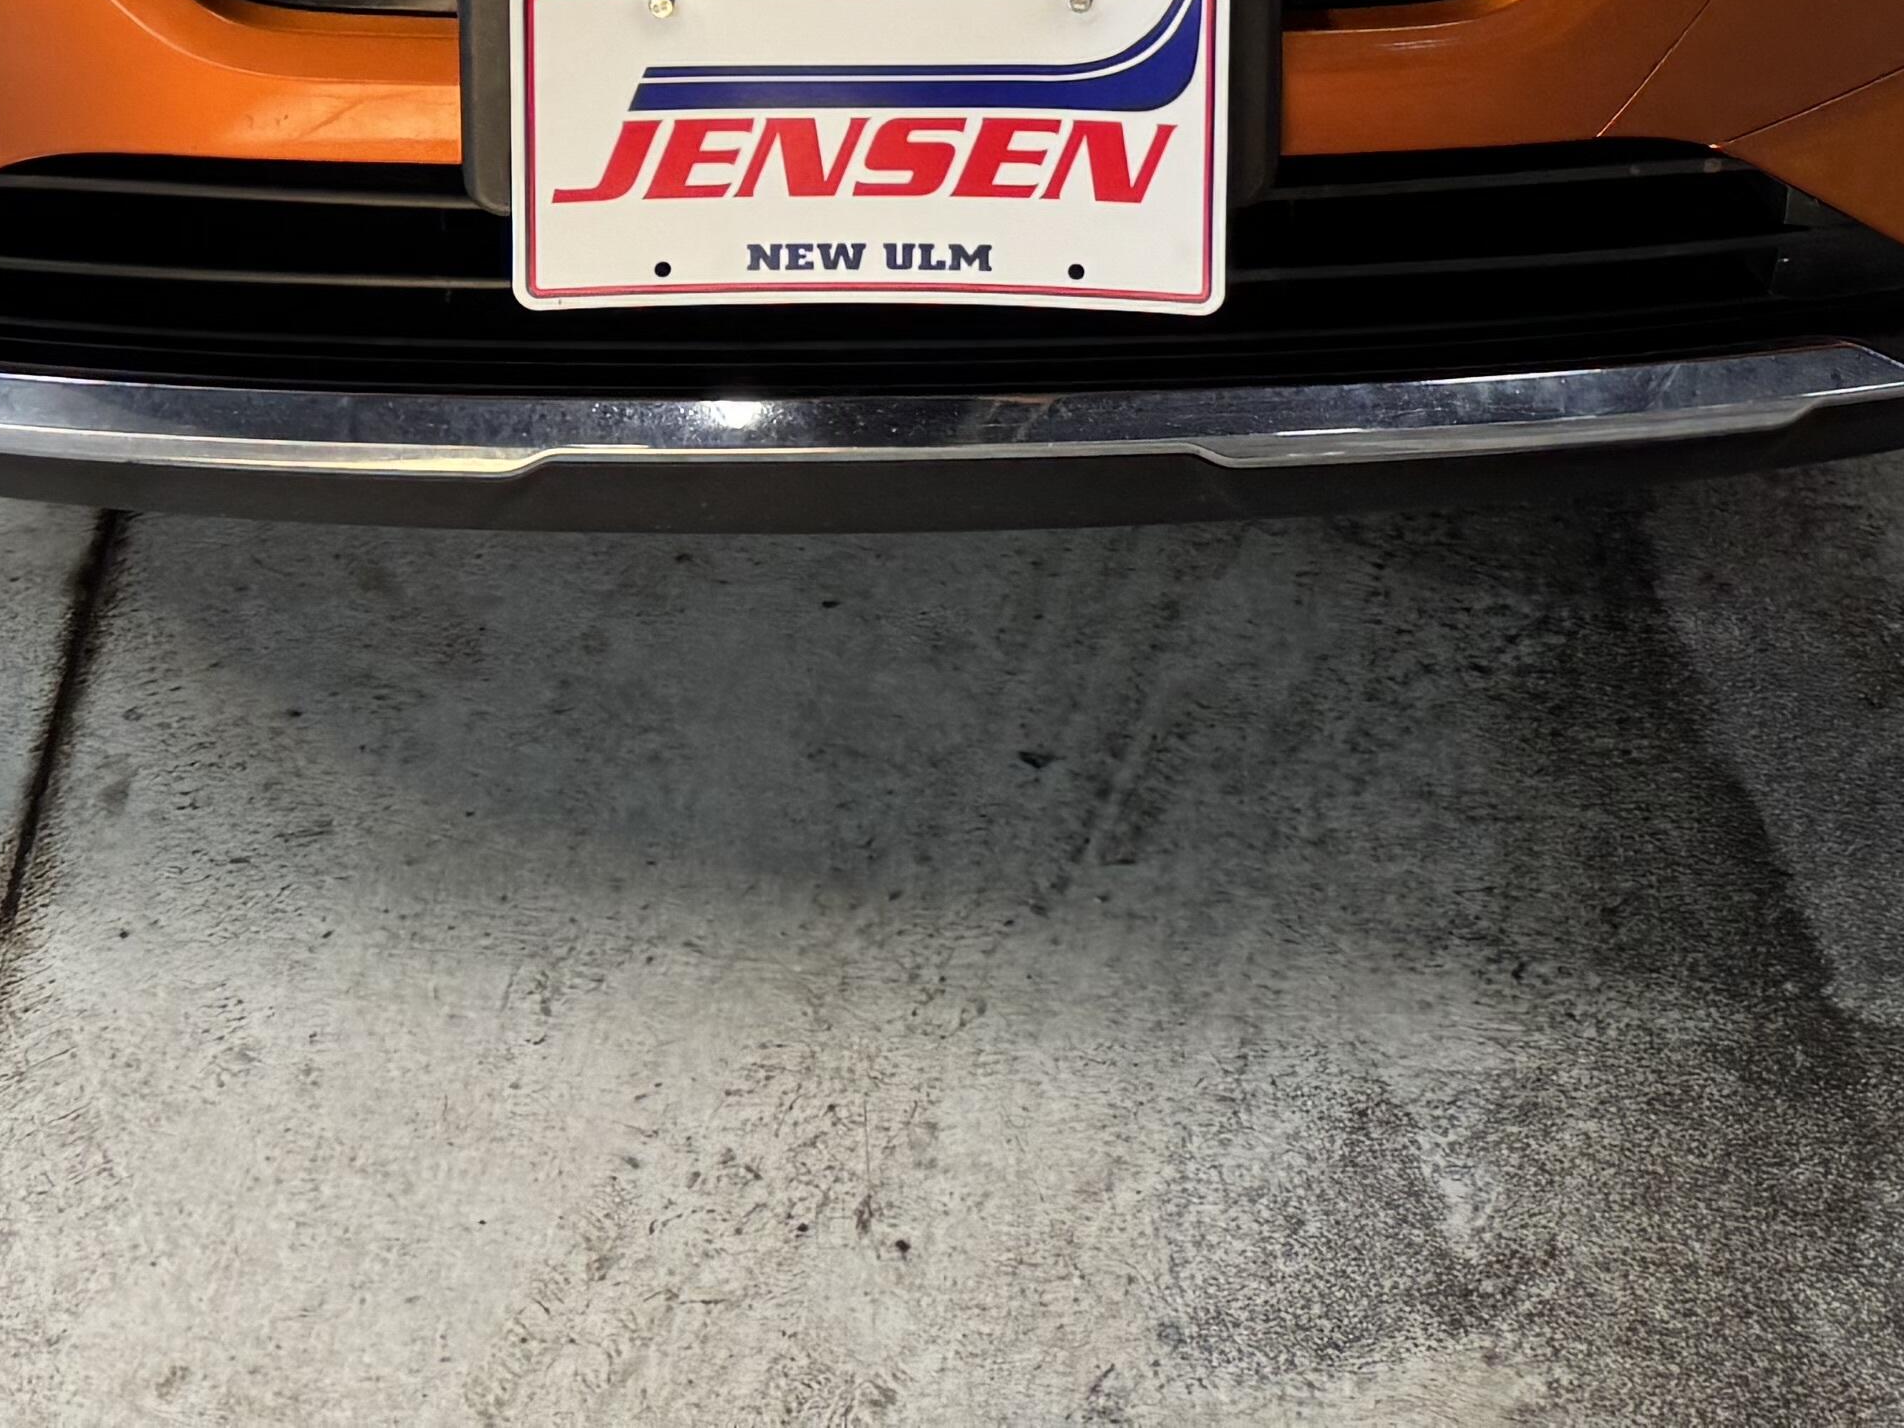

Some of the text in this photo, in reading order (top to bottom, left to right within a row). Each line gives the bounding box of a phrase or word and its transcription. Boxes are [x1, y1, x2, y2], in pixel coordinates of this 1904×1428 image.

[552, 116, 1178, 205] JENSEN
[747, 243, 993, 272] NEW ULM
